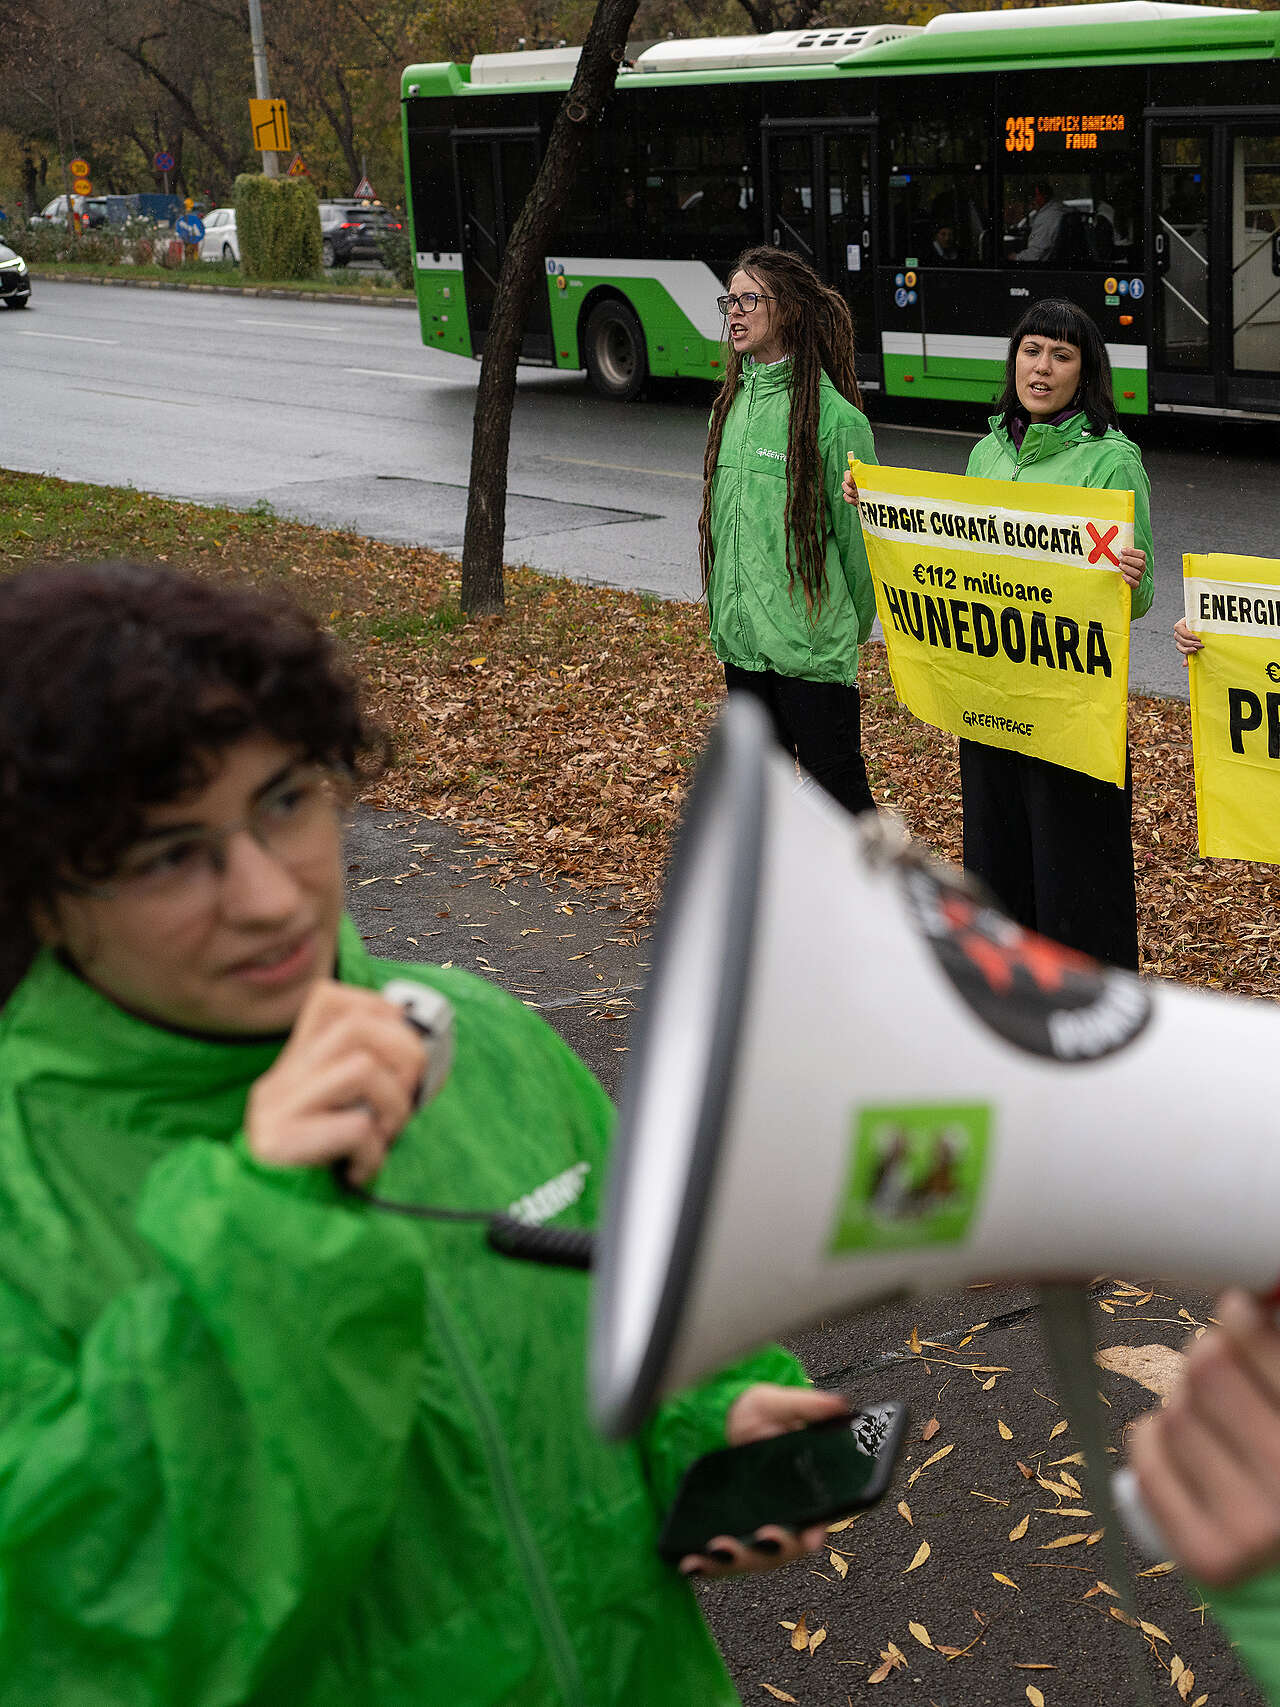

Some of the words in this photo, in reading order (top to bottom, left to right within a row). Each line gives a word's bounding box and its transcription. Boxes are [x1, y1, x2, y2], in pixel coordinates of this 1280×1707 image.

[1005, 117, 1035, 151] 335
[1037, 115, 1080, 131] COMPLEX
[1065, 133, 1097, 149] FAUR
[860, 501, 927, 533] ENERGIE
[930, 514, 1000, 544] CURATĂ
[1003, 521, 1084, 556] BLOCATĂ
[912, 563, 957, 590] €112
[963, 571, 1053, 604] milioane
[882, 581, 1112, 678] HUNEDOARA
[962, 710, 1034, 736] GREENPEACE
